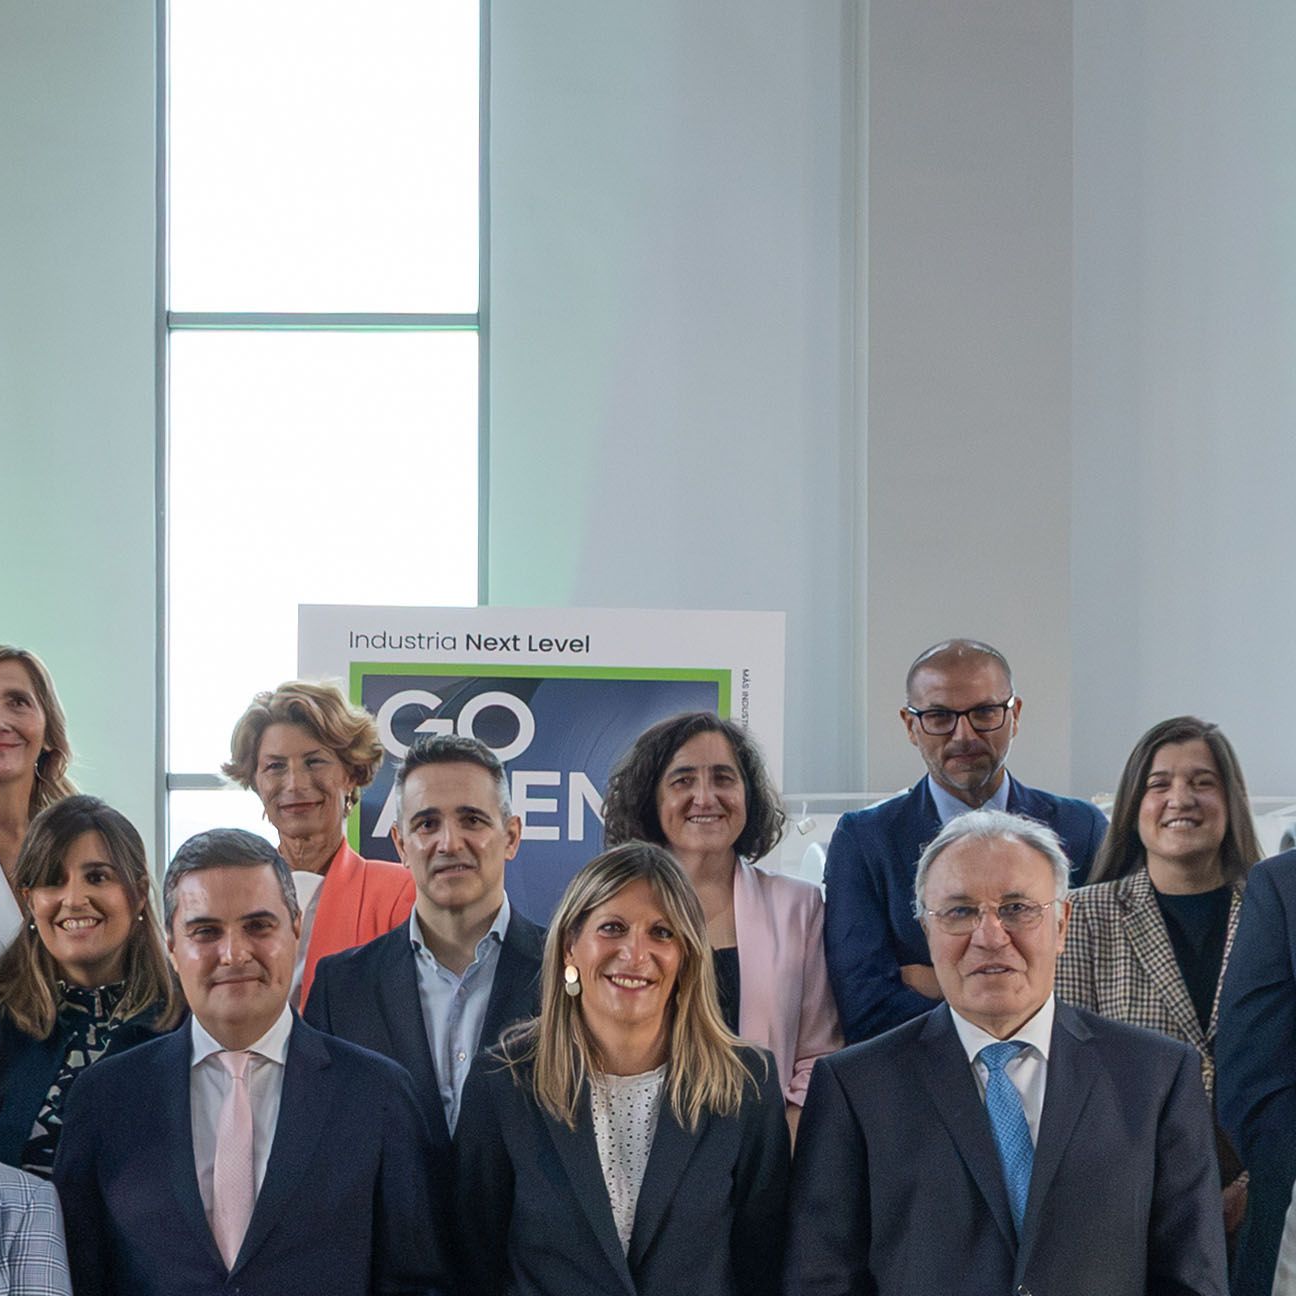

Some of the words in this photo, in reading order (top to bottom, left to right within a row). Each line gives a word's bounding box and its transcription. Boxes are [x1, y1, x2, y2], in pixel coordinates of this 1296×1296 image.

[349, 631, 456, 650] Industria
[466, 634, 520, 652] Next
[528, 635, 590, 653] Level
[376, 689, 536, 764] GO
